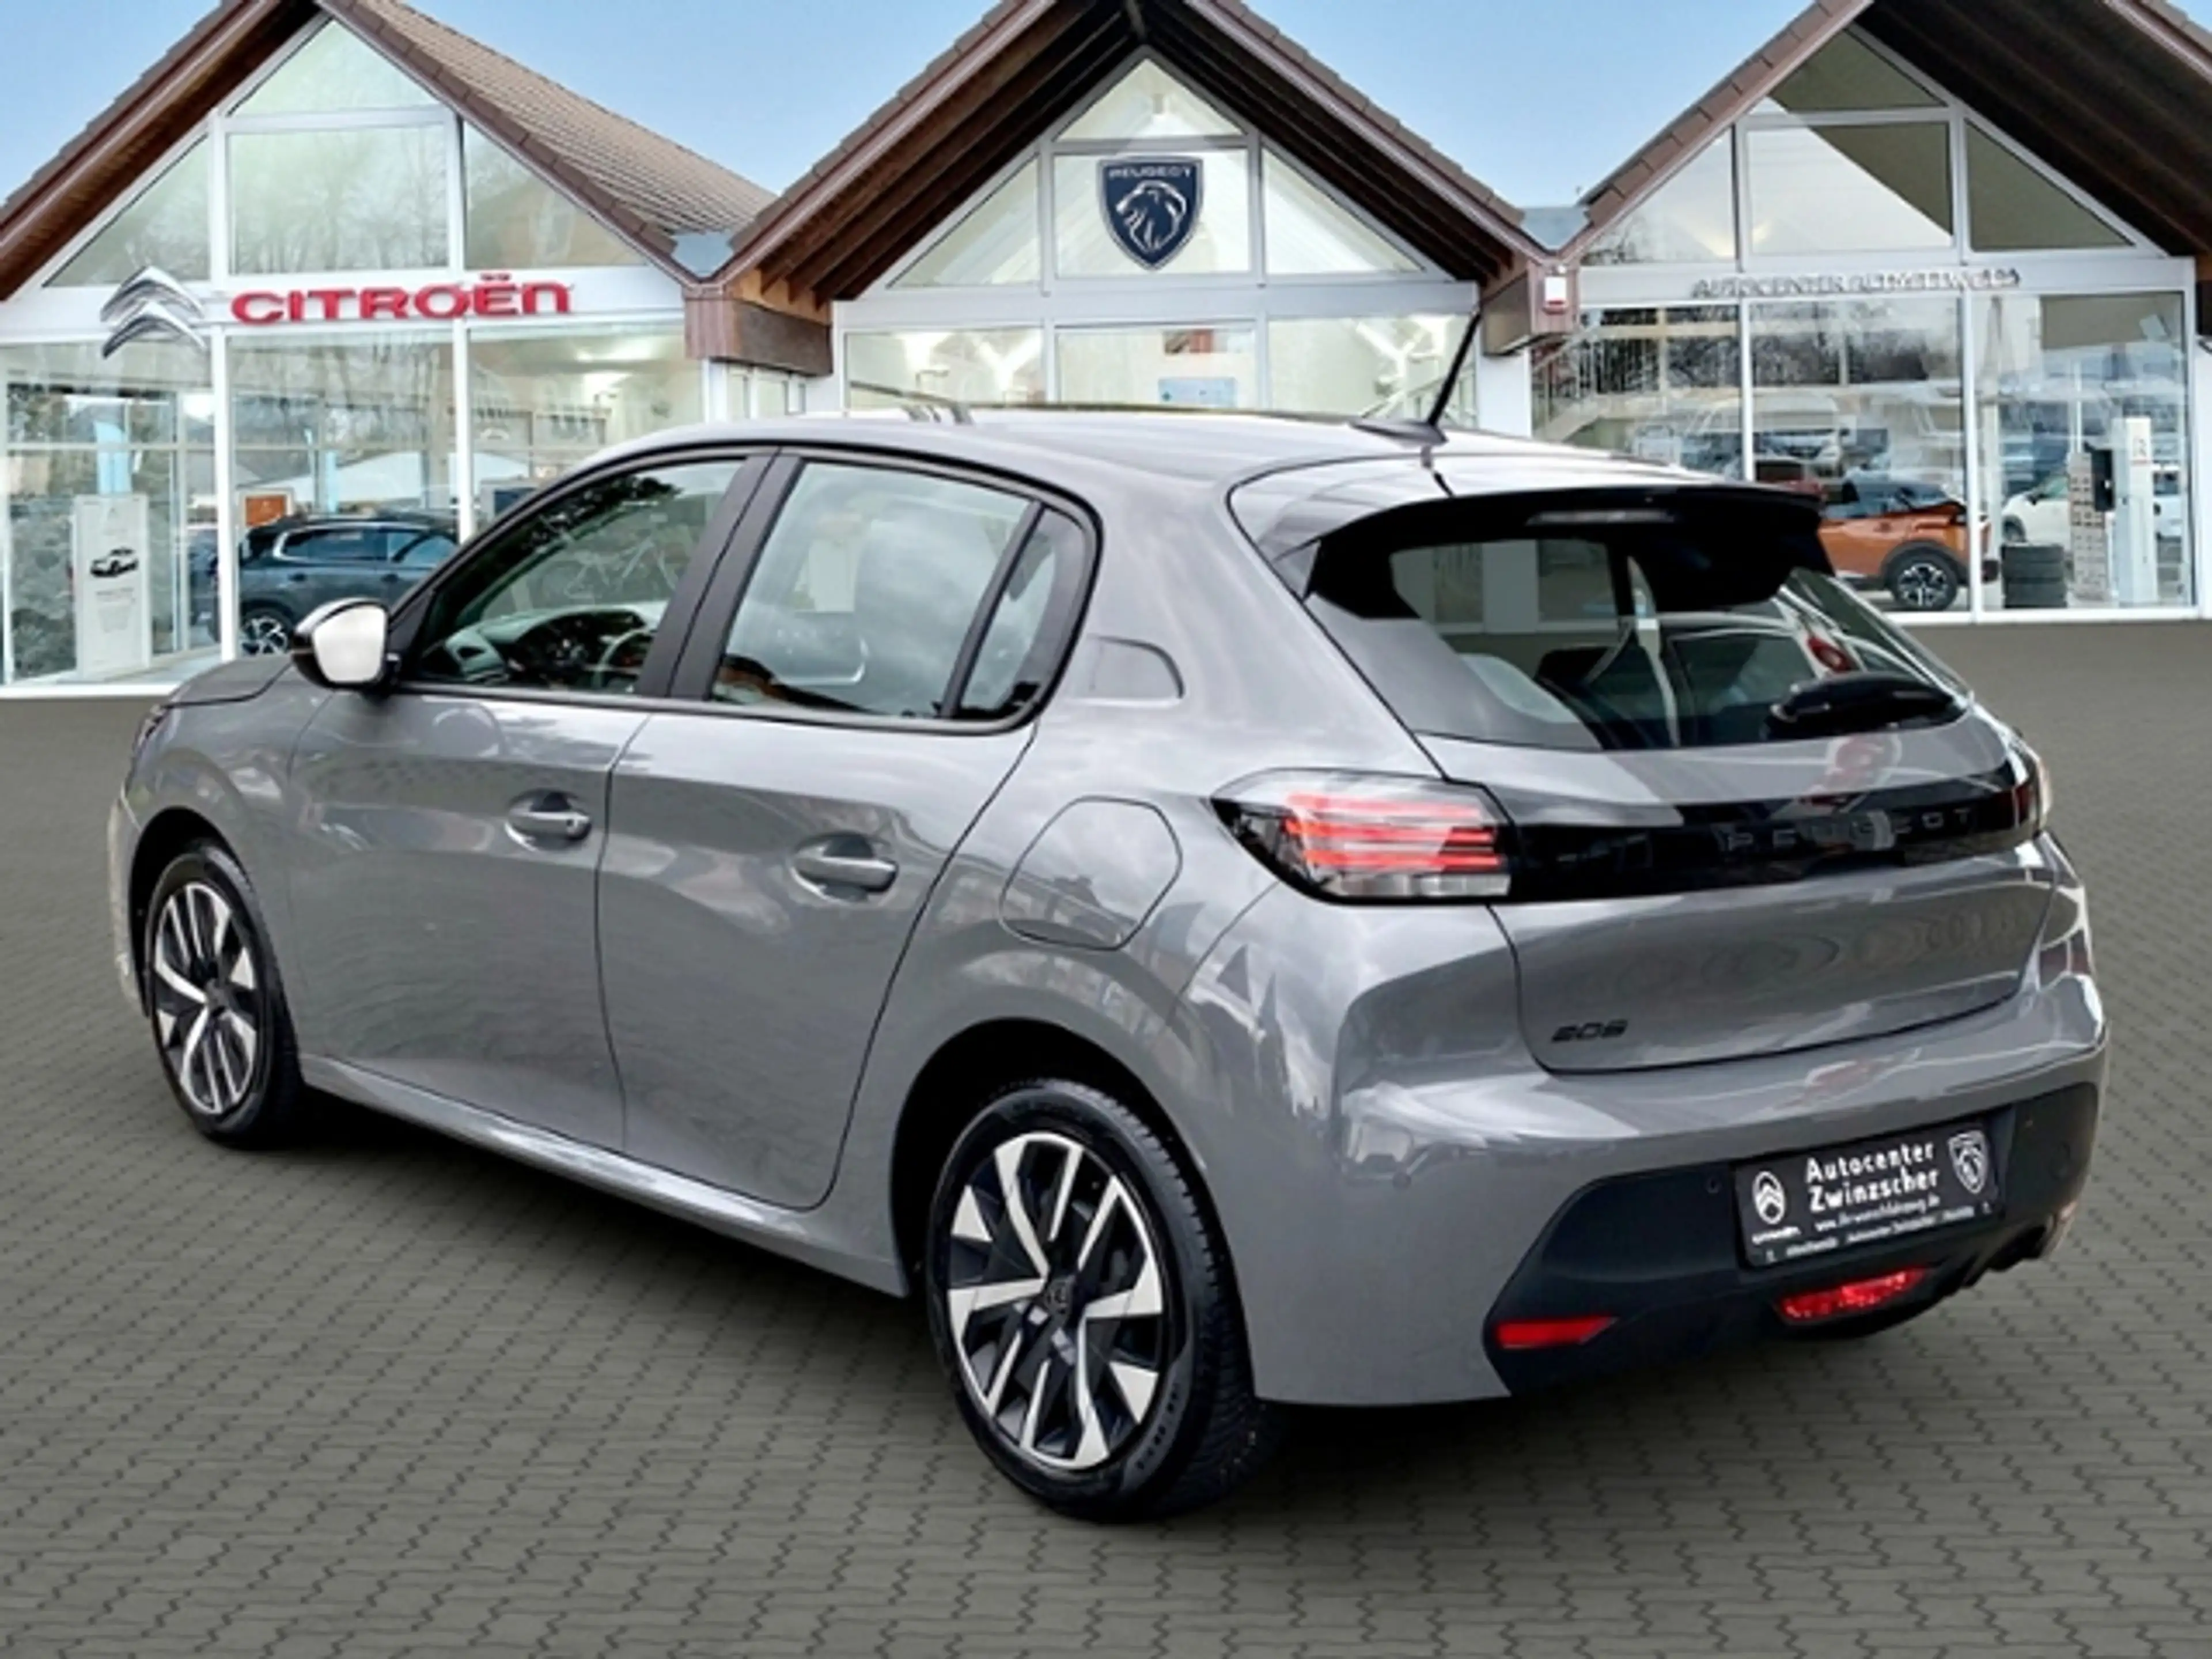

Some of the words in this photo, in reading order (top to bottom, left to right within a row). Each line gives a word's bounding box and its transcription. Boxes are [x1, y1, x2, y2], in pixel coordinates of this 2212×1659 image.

[230, 273, 571, 325] CITROËN
[1805, 1141, 1936, 1184] Autocenter
[1808, 1168, 1940, 1213] Zwinzscher
